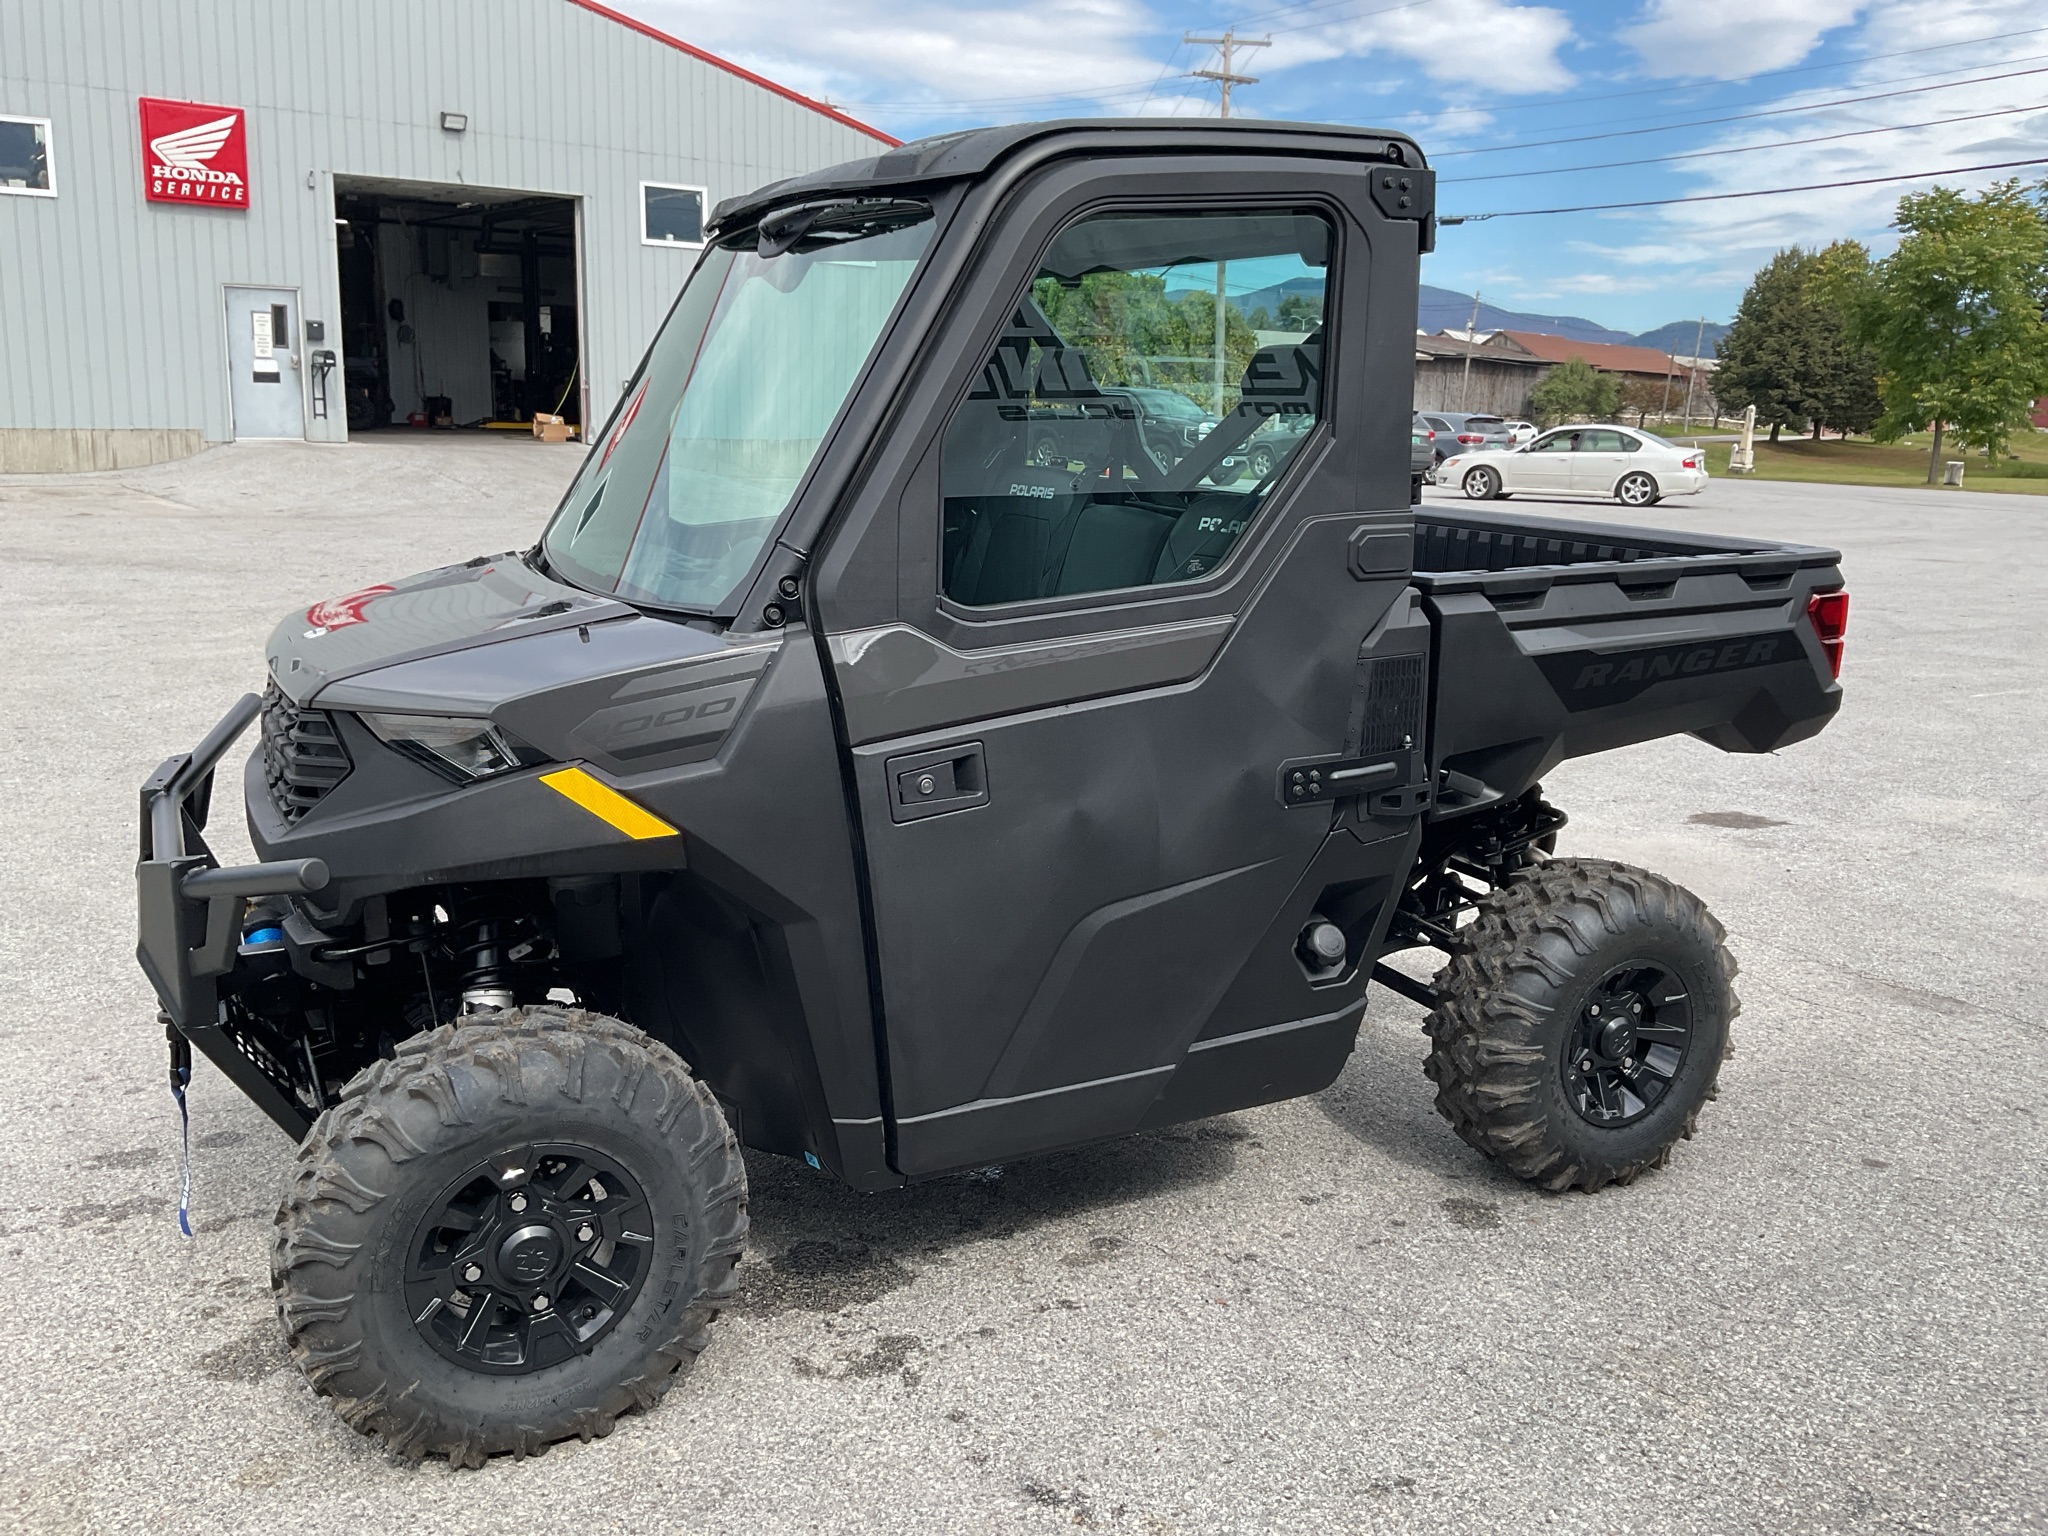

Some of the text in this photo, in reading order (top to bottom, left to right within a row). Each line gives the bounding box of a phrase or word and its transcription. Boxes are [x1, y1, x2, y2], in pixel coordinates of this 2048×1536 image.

[152, 165, 244, 185] HONDA
[153, 180, 244, 200] SERVICE
[1009, 483, 1055, 499] POLARIS
[1572, 638, 1780, 690] RANGER
